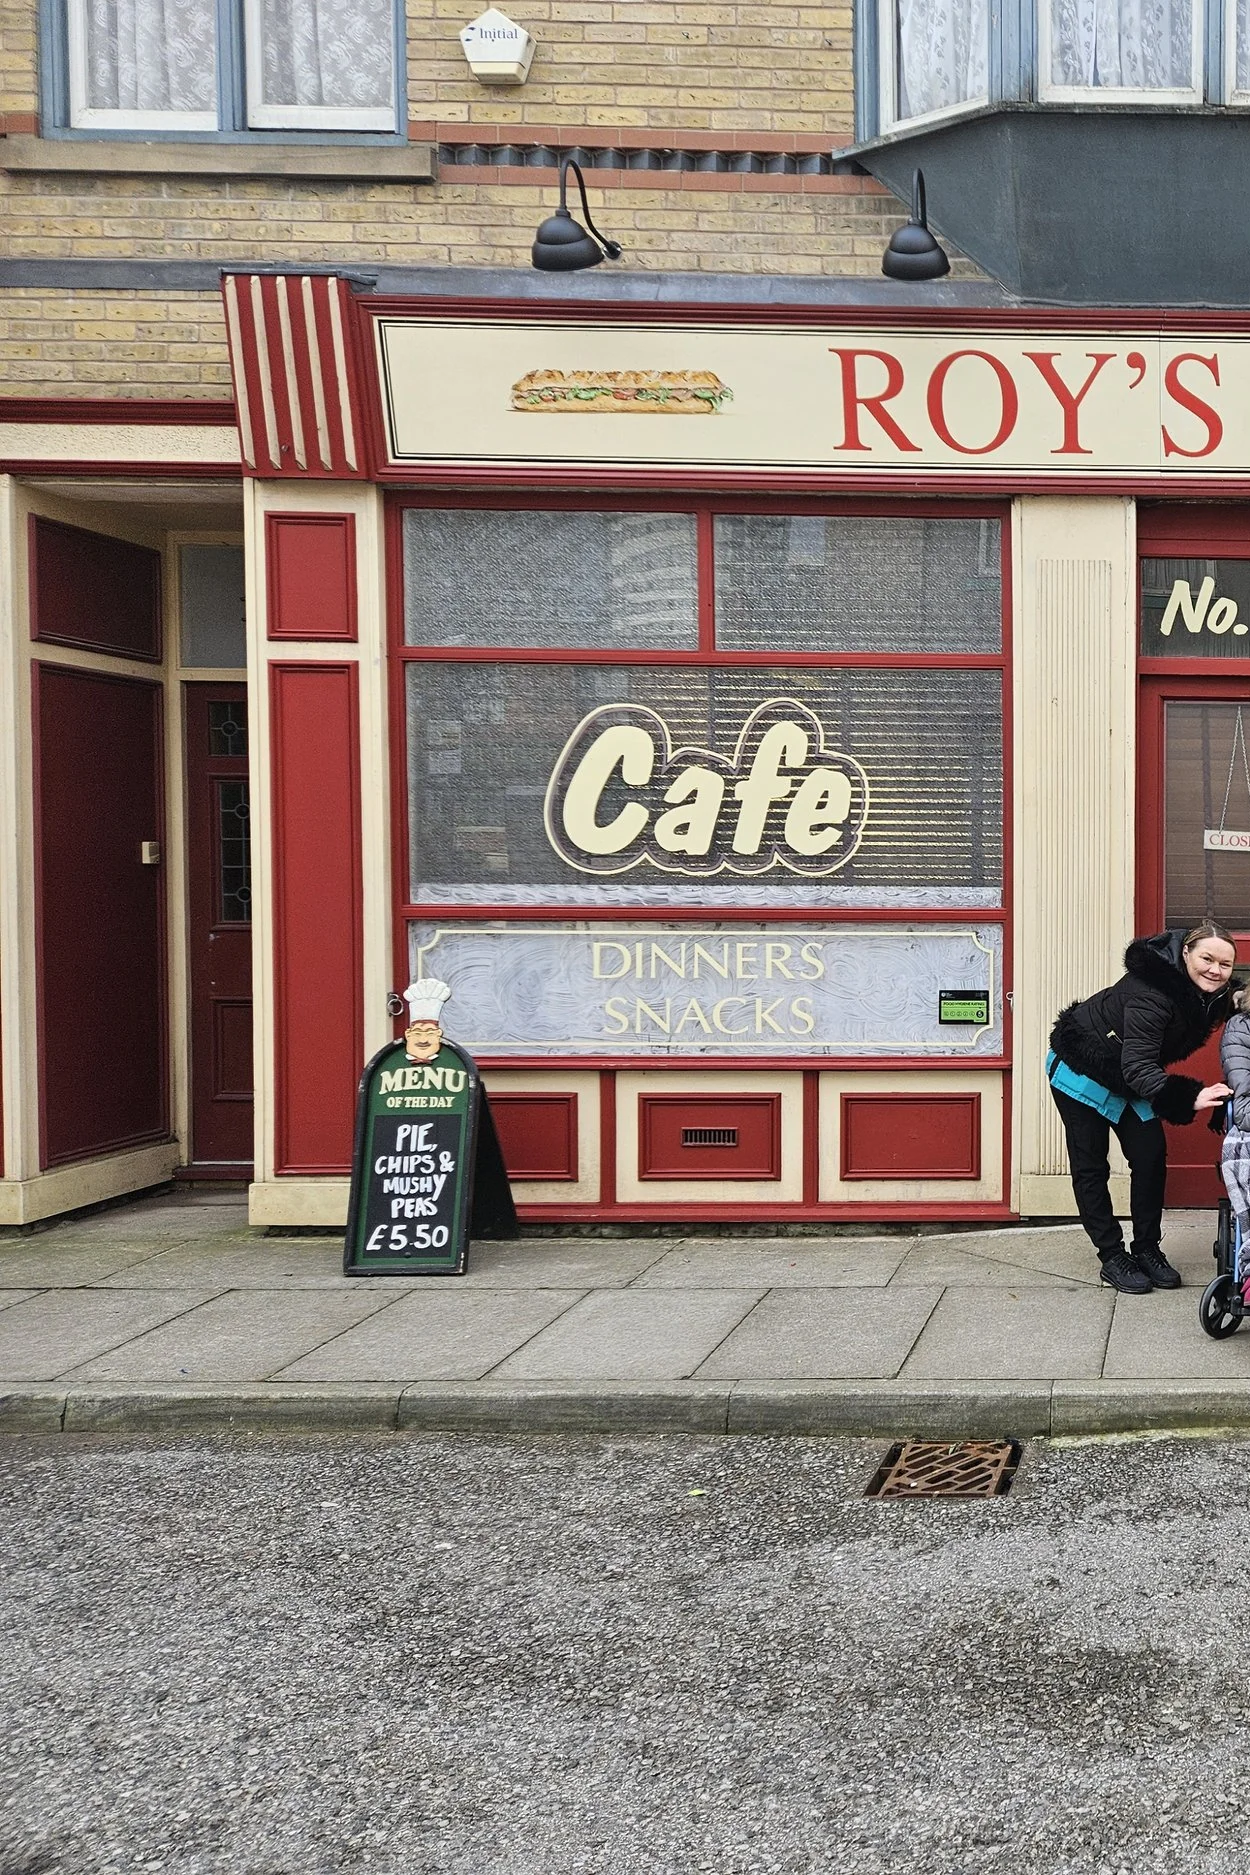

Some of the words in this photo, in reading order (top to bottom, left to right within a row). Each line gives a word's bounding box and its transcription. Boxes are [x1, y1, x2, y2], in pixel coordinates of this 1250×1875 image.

[480, 28, 518, 39] Initial
[828, 348, 1223, 457] ROY'S
[1160, 576, 1249, 636] No.
[562, 721, 852, 856] Cafe
[592, 942, 826, 980] DINNERS
[603, 996, 816, 1035] SNACKS
[379, 1066, 467, 1095] MENU
[386, 1096, 403, 1108] OF
[404, 1096, 428, 1108] THE
[429, 1096, 455, 1108] DAY
[396, 1123, 438, 1152] PIE,
[374, 1155, 435, 1175] CHIPS
[439, 1151, 455, 1172] &
[383, 1174, 447, 1201] MUSHY
[391, 1197, 438, 1218] PEAS
